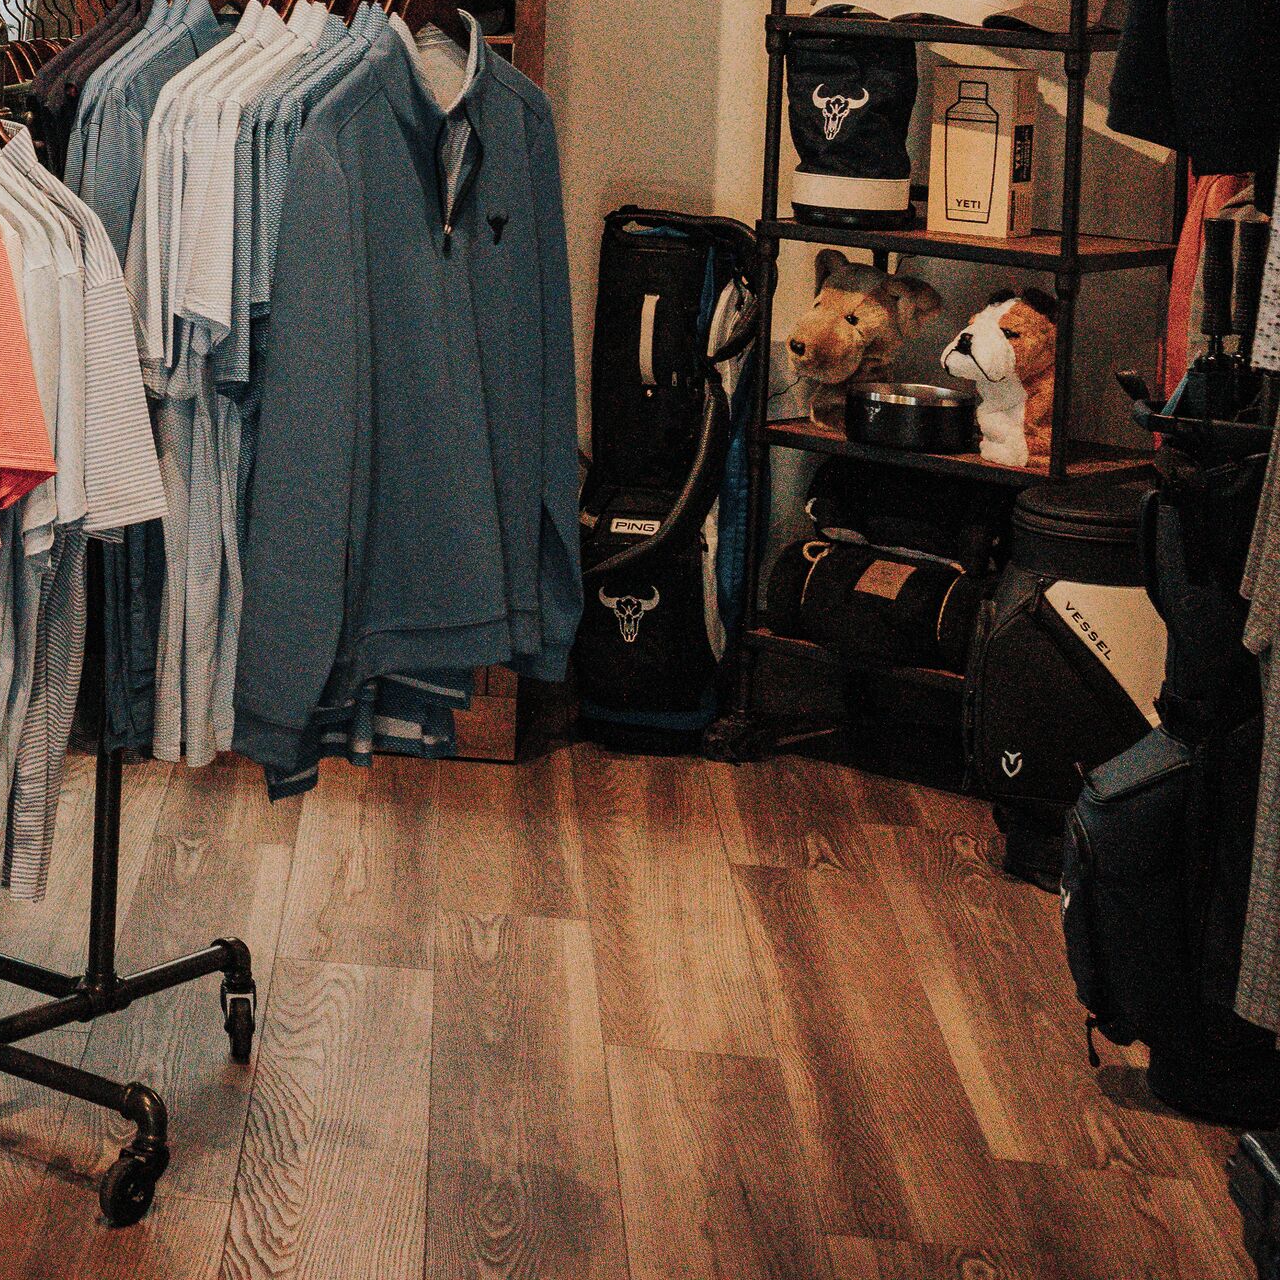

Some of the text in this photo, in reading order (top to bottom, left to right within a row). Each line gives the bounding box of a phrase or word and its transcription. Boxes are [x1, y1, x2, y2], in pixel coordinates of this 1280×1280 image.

[956, 198, 981, 209] YETI
[615, 521, 655, 531] PING
[1065, 601, 1111, 661] VESSEL
